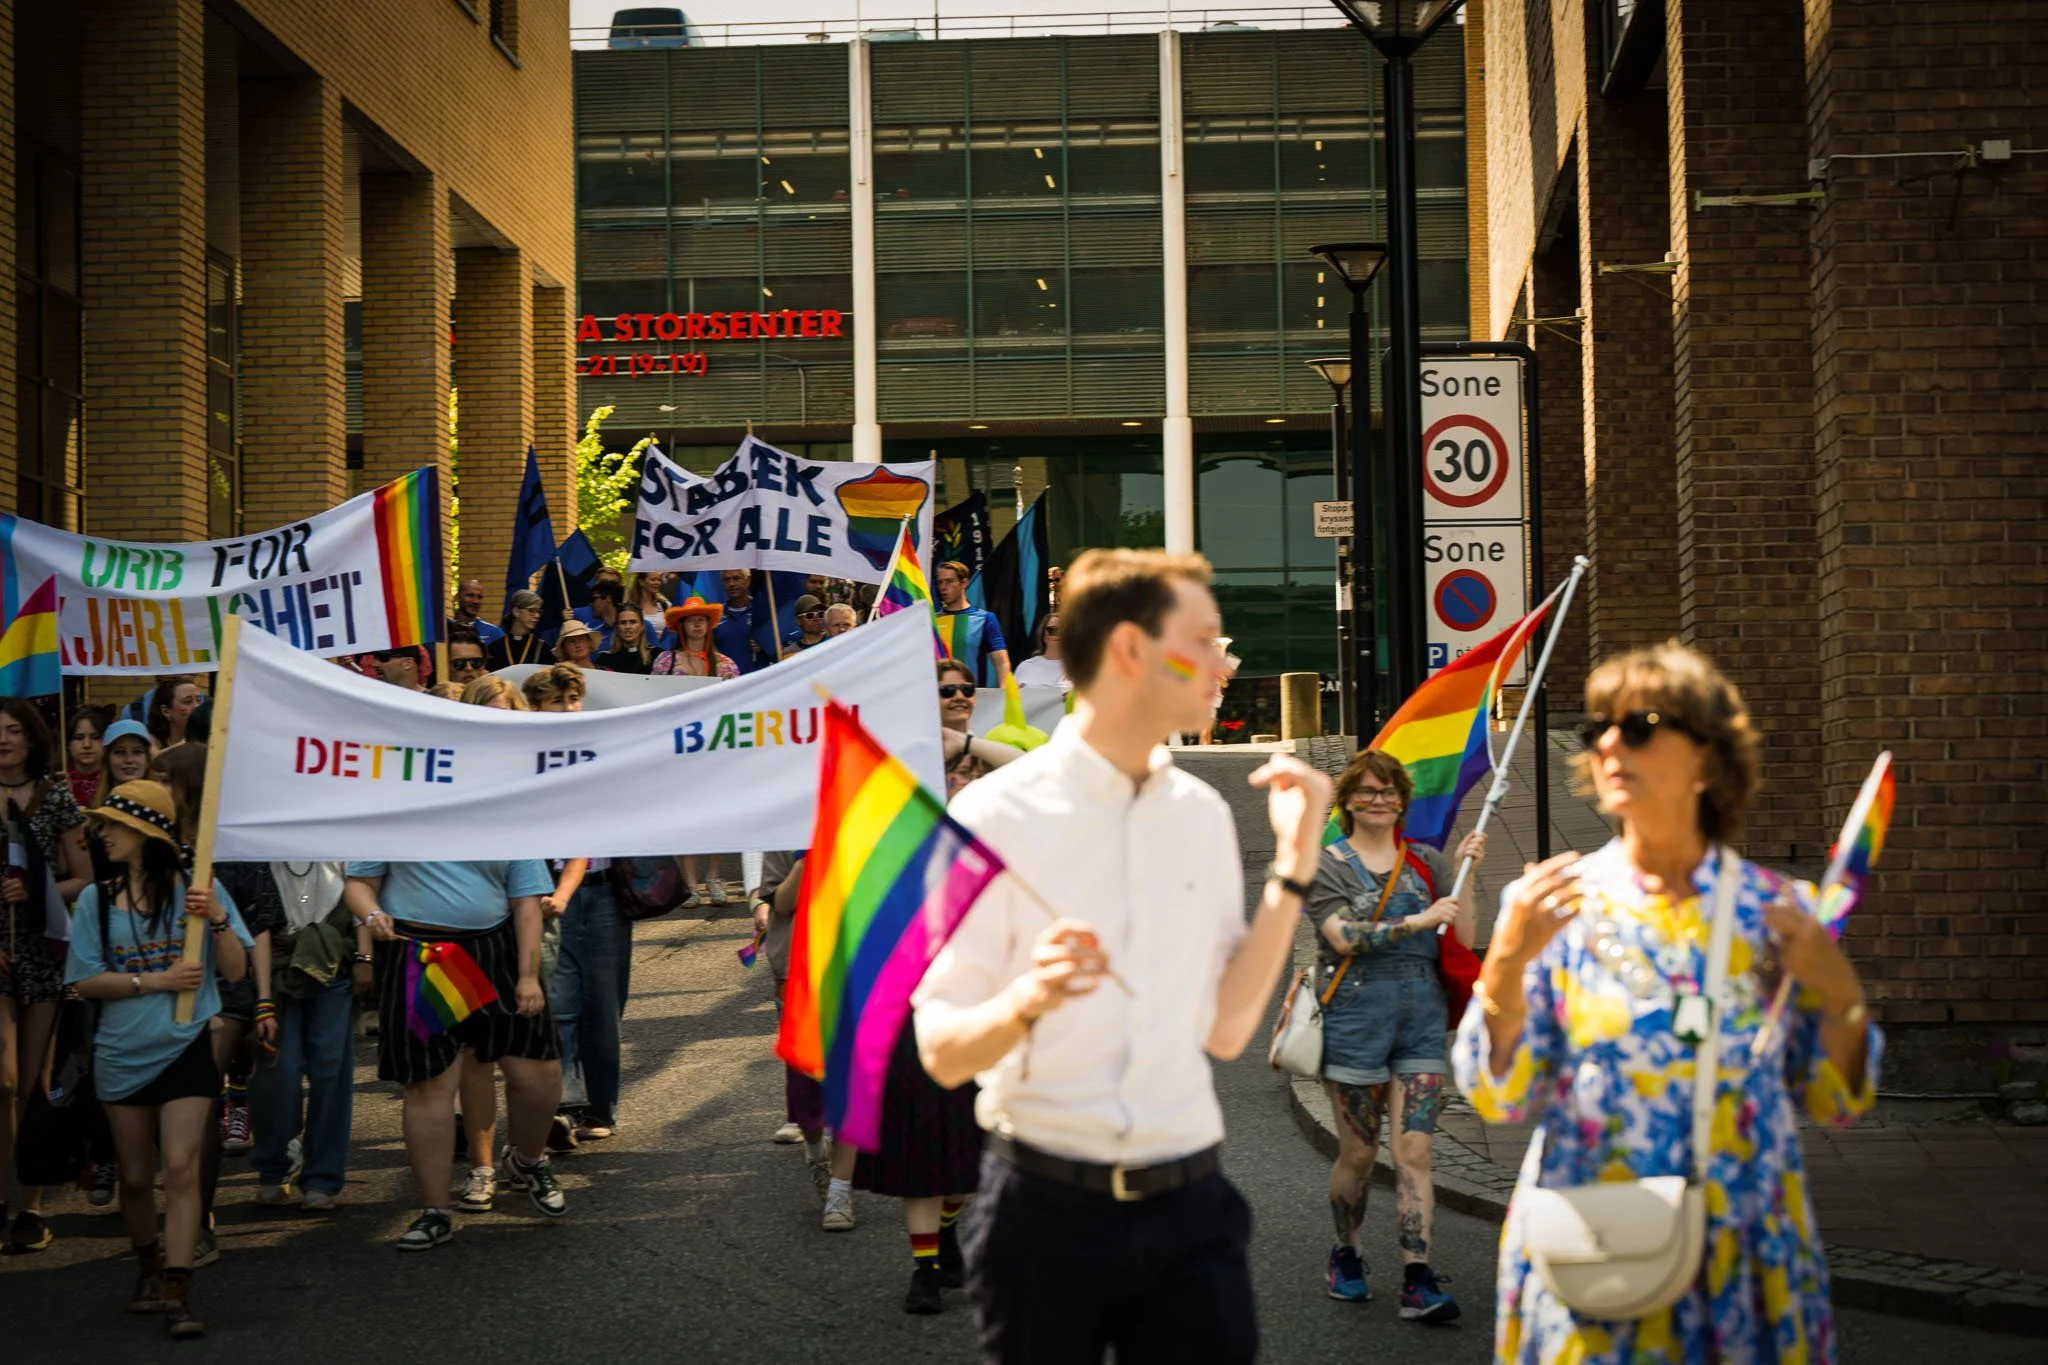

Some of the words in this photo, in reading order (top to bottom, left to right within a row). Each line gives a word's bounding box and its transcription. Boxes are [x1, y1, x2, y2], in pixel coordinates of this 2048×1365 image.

[615, 310, 842, 342] STORSENTER
[629, 351, 707, 379] (9-19)
[1420, 370, 1501, 397] Sone
[639, 443, 825, 507] STABÆK
[1434, 439, 1491, 482] 30
[632, 517, 719, 559] FOR
[734, 505, 832, 557] ALLE
[1424, 535, 1505, 563] Sone
[81, 541, 184, 590] URB
[211, 522, 312, 587] FOR
[295, 736, 454, 783] DETTE
[674, 705, 859, 754] BÆRU
